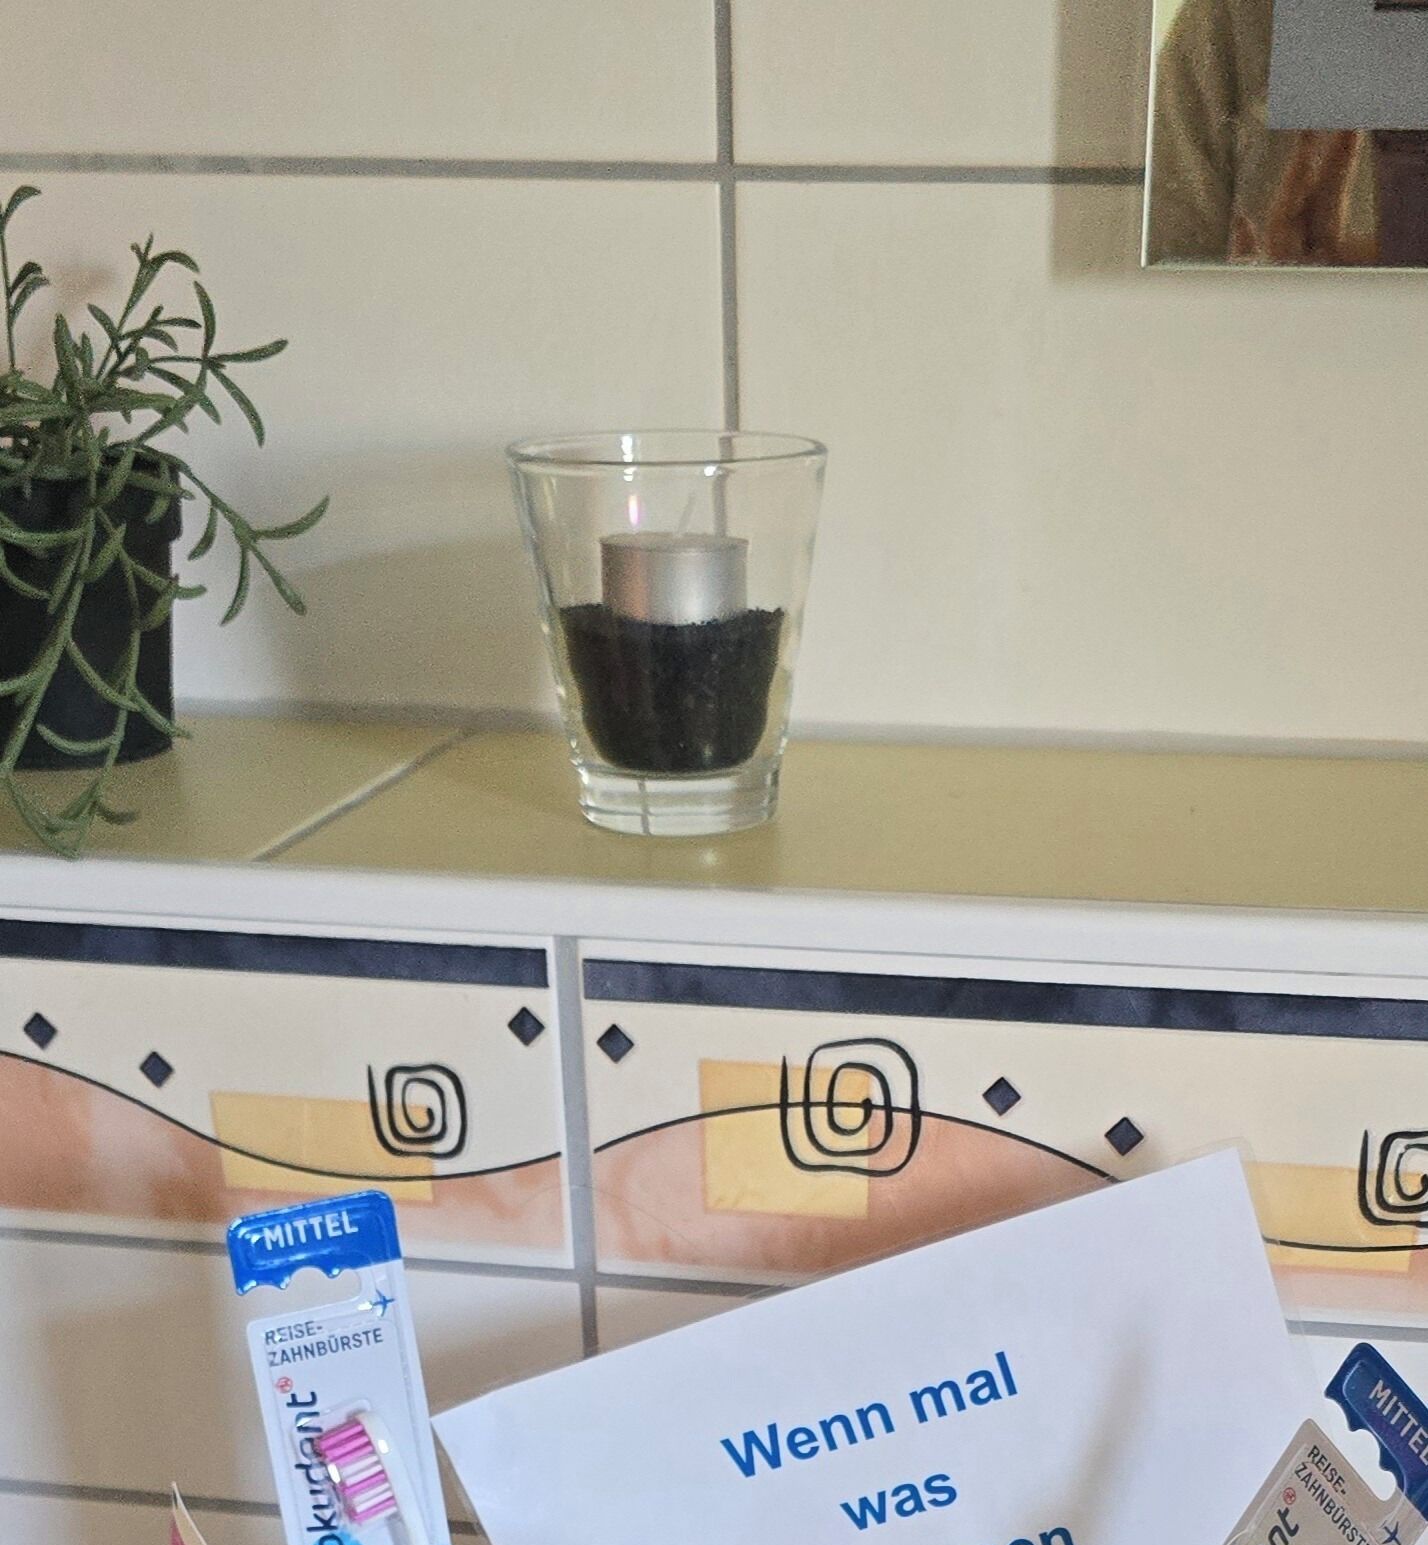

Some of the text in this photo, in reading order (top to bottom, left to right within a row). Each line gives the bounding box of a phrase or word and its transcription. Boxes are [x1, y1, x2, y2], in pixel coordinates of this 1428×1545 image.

[263, 1210, 359, 1251] MITTEL
[264, 1320, 324, 1346] REISE-
[268, 1327, 384, 1367] ZAHNBÜRSTE
[720, 1350, 1018, 1478] Wenn mal
[1307, 1445, 1347, 1496] REISE-
[840, 1473, 957, 1531] was
